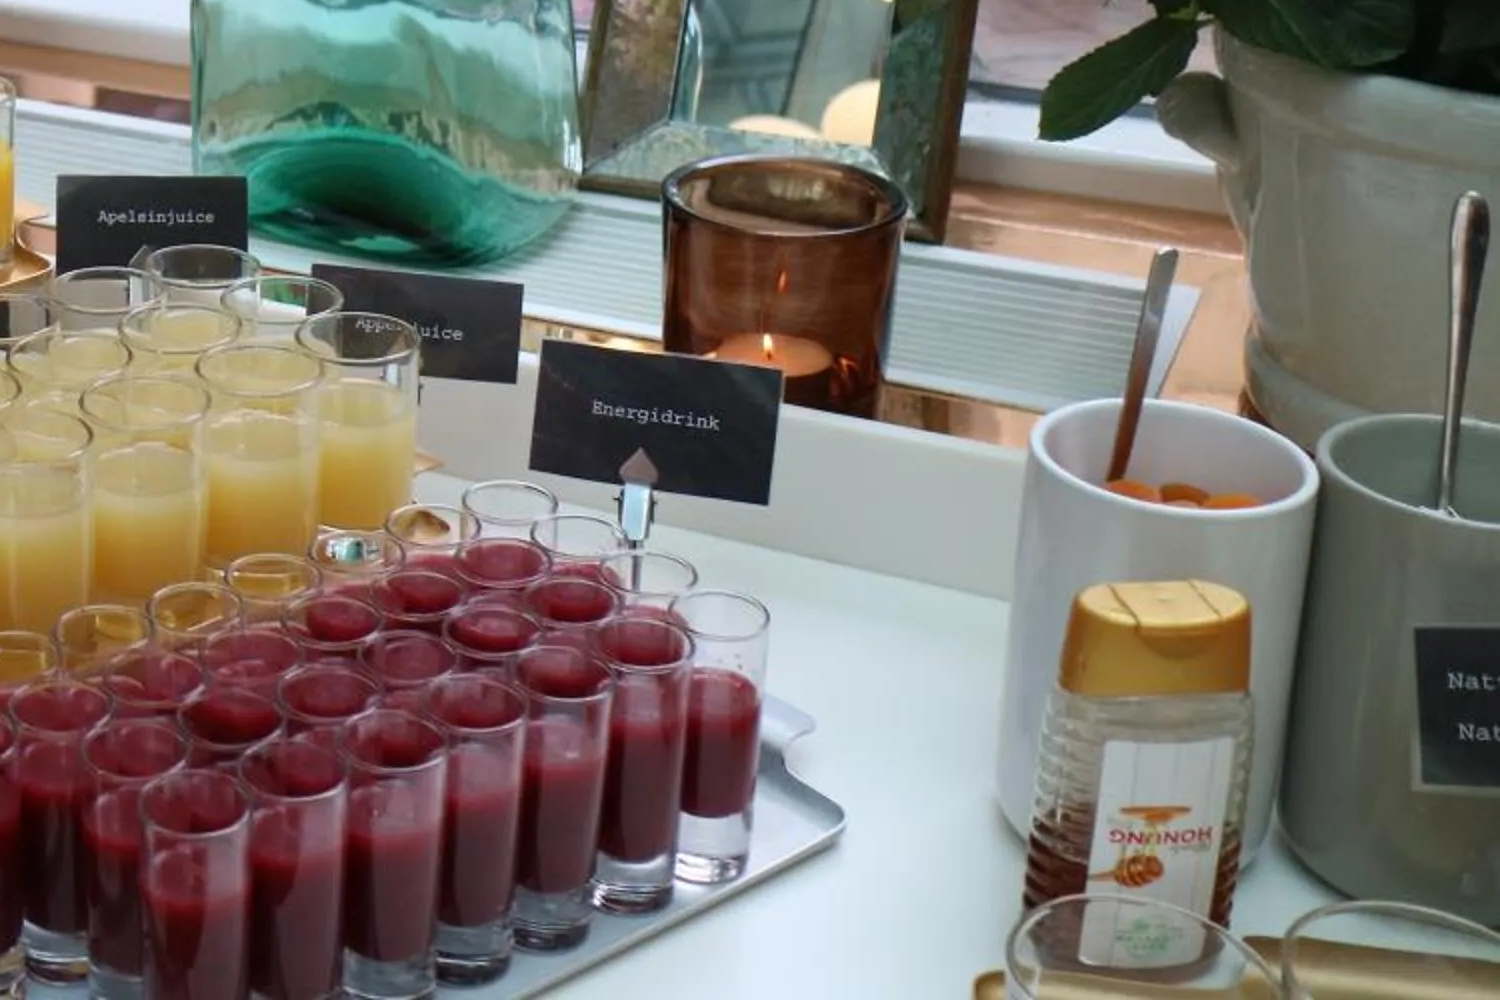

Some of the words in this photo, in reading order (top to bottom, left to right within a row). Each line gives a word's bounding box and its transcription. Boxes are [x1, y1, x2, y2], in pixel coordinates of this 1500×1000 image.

[97, 209, 216, 227] Apelsinjuice
[591, 398, 721, 431] Energidrink
[1447, 672, 1500, 691] Nat
